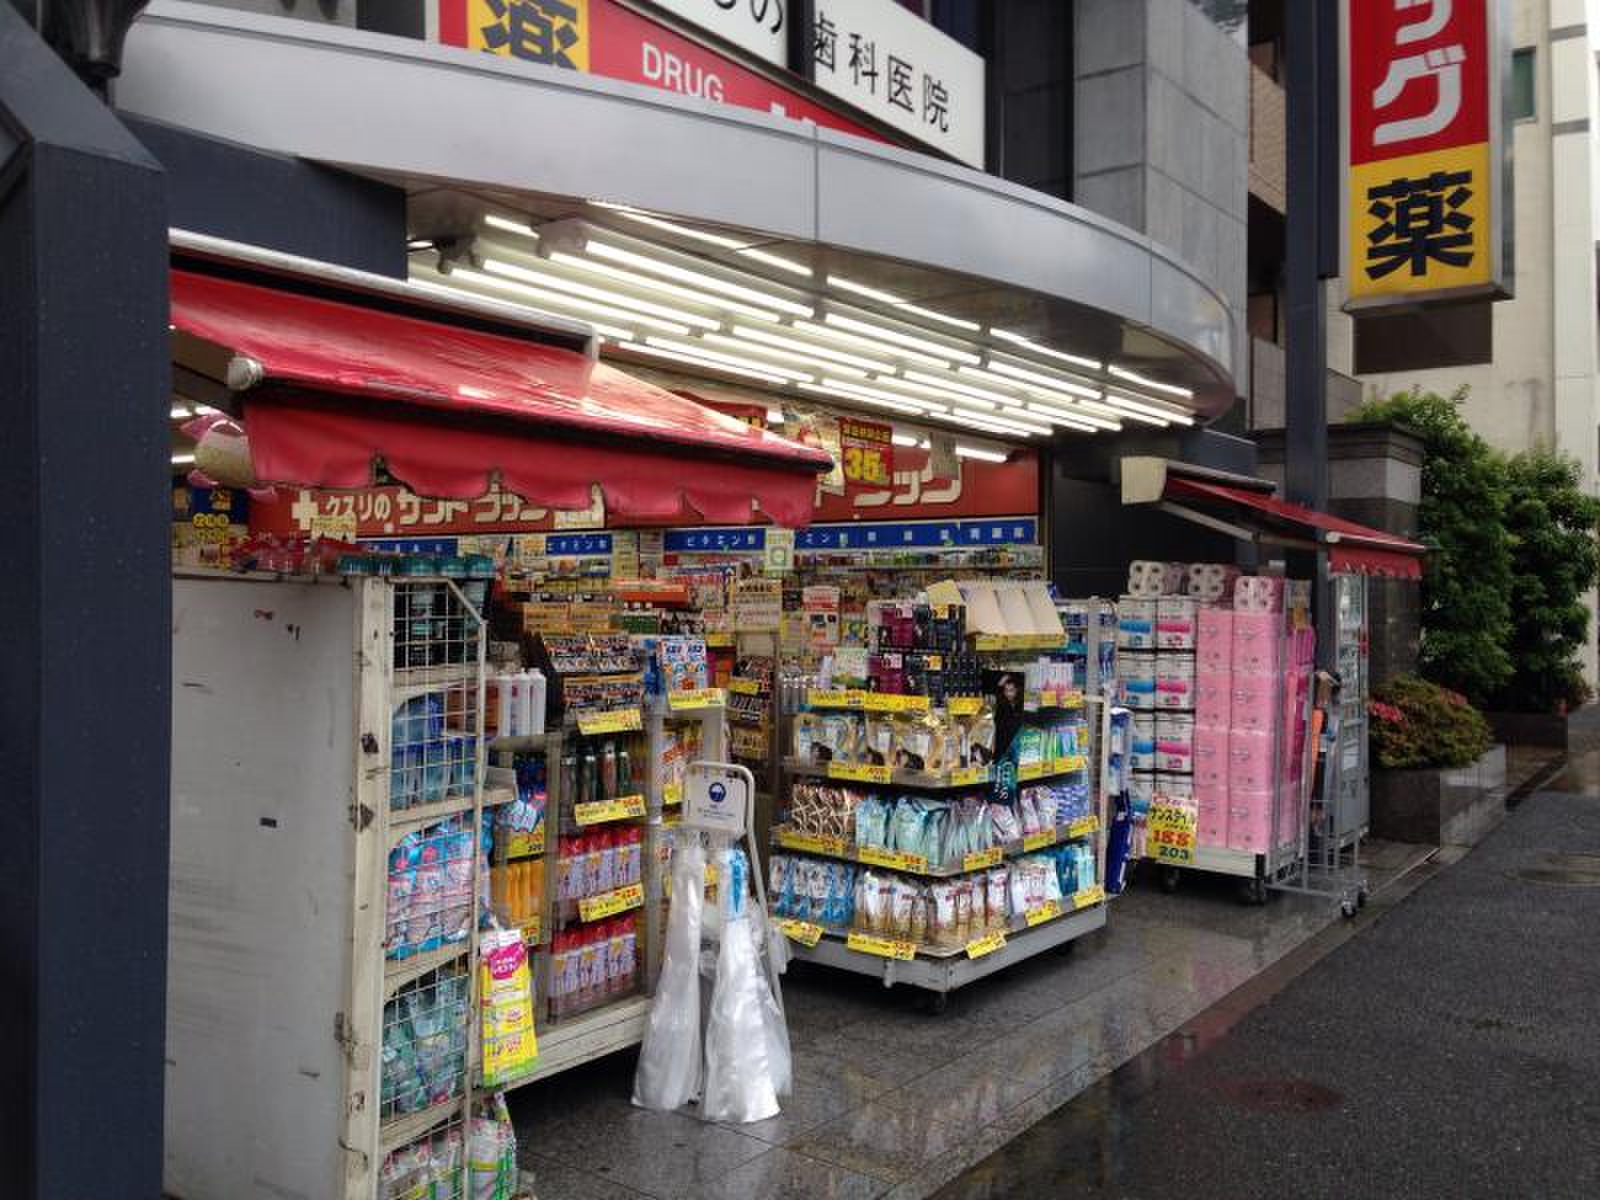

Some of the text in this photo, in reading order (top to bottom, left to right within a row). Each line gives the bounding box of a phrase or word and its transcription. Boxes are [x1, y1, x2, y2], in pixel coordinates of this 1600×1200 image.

[641, 41, 725, 103] DRUG
[813, 11, 950, 133] 歯科医院
[1364, 170, 1474, 281] 薬
